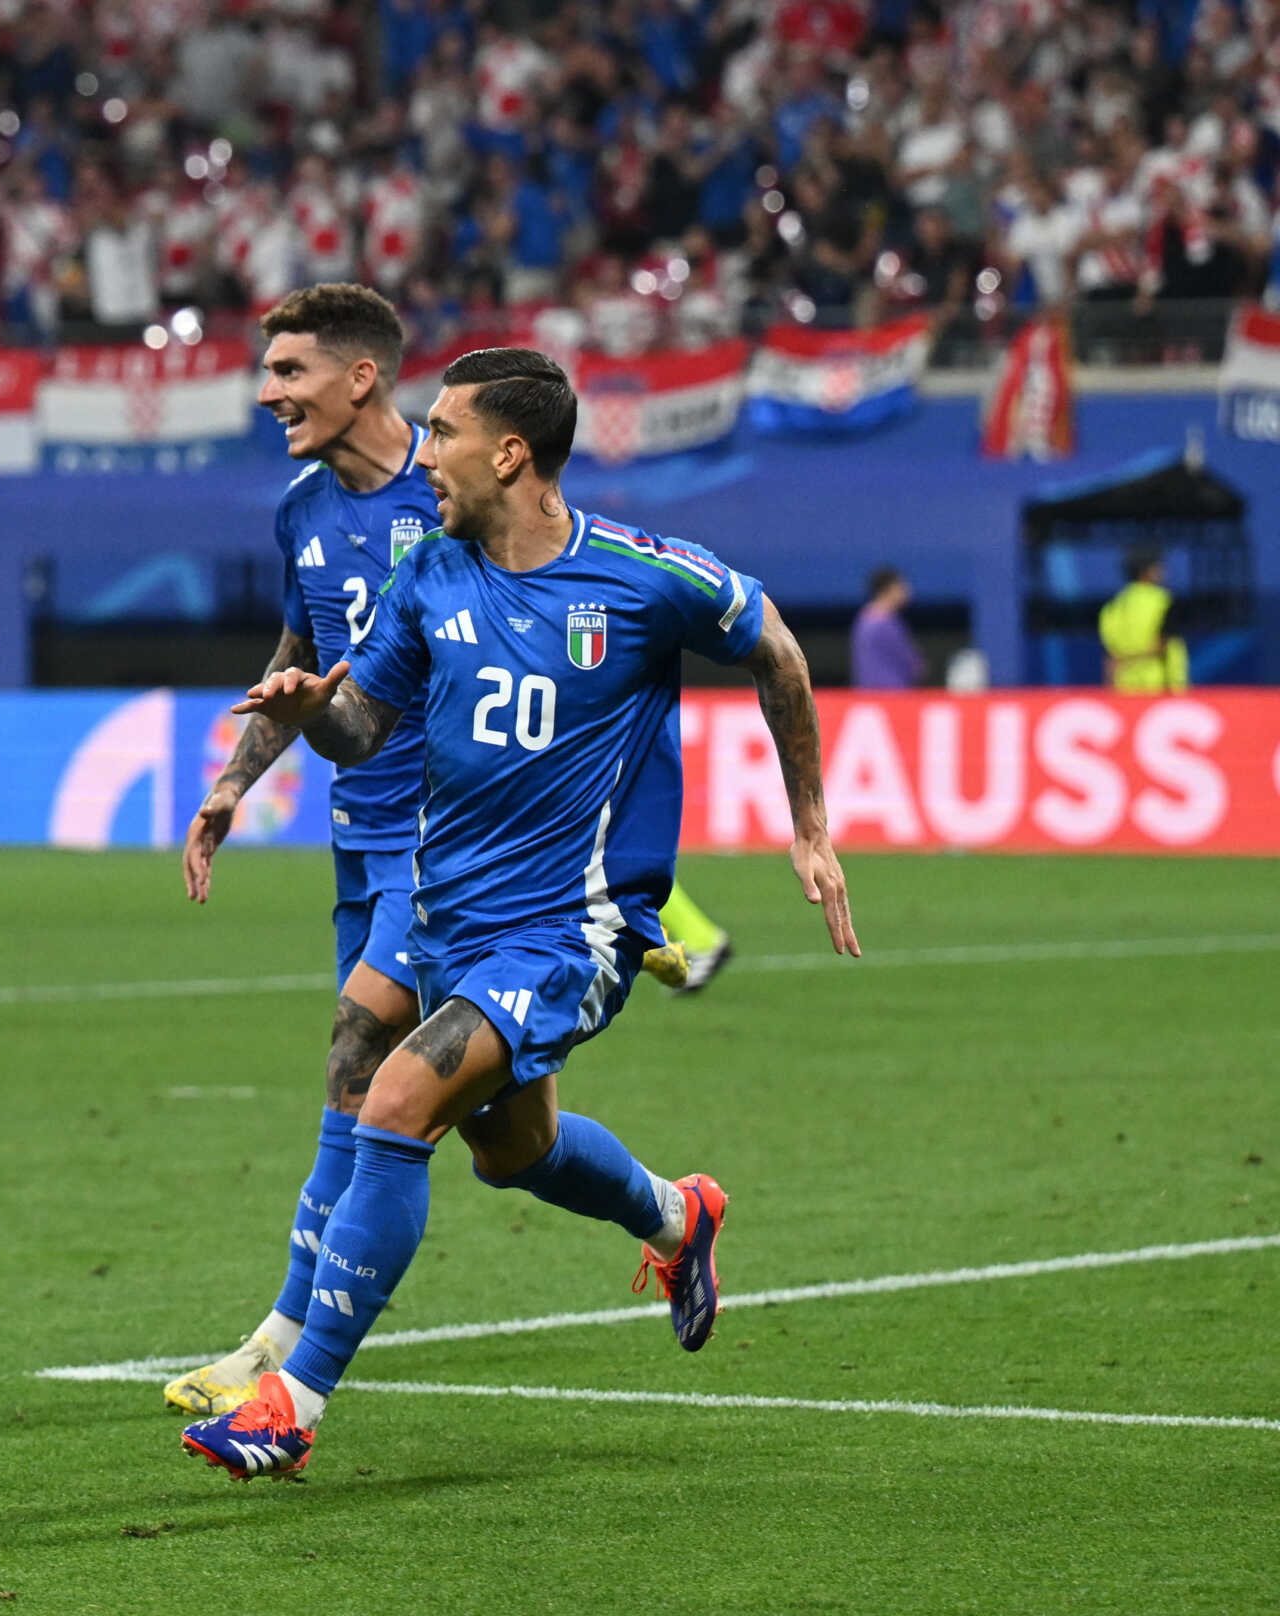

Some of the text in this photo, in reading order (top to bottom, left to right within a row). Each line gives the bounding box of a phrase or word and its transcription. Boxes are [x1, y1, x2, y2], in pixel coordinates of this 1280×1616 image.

[394, 531, 421, 542] ITALIA
[570, 617, 604, 628] ITALIA
[473, 666, 557, 751] 20
[321, 1244, 377, 1280] ITALIA
